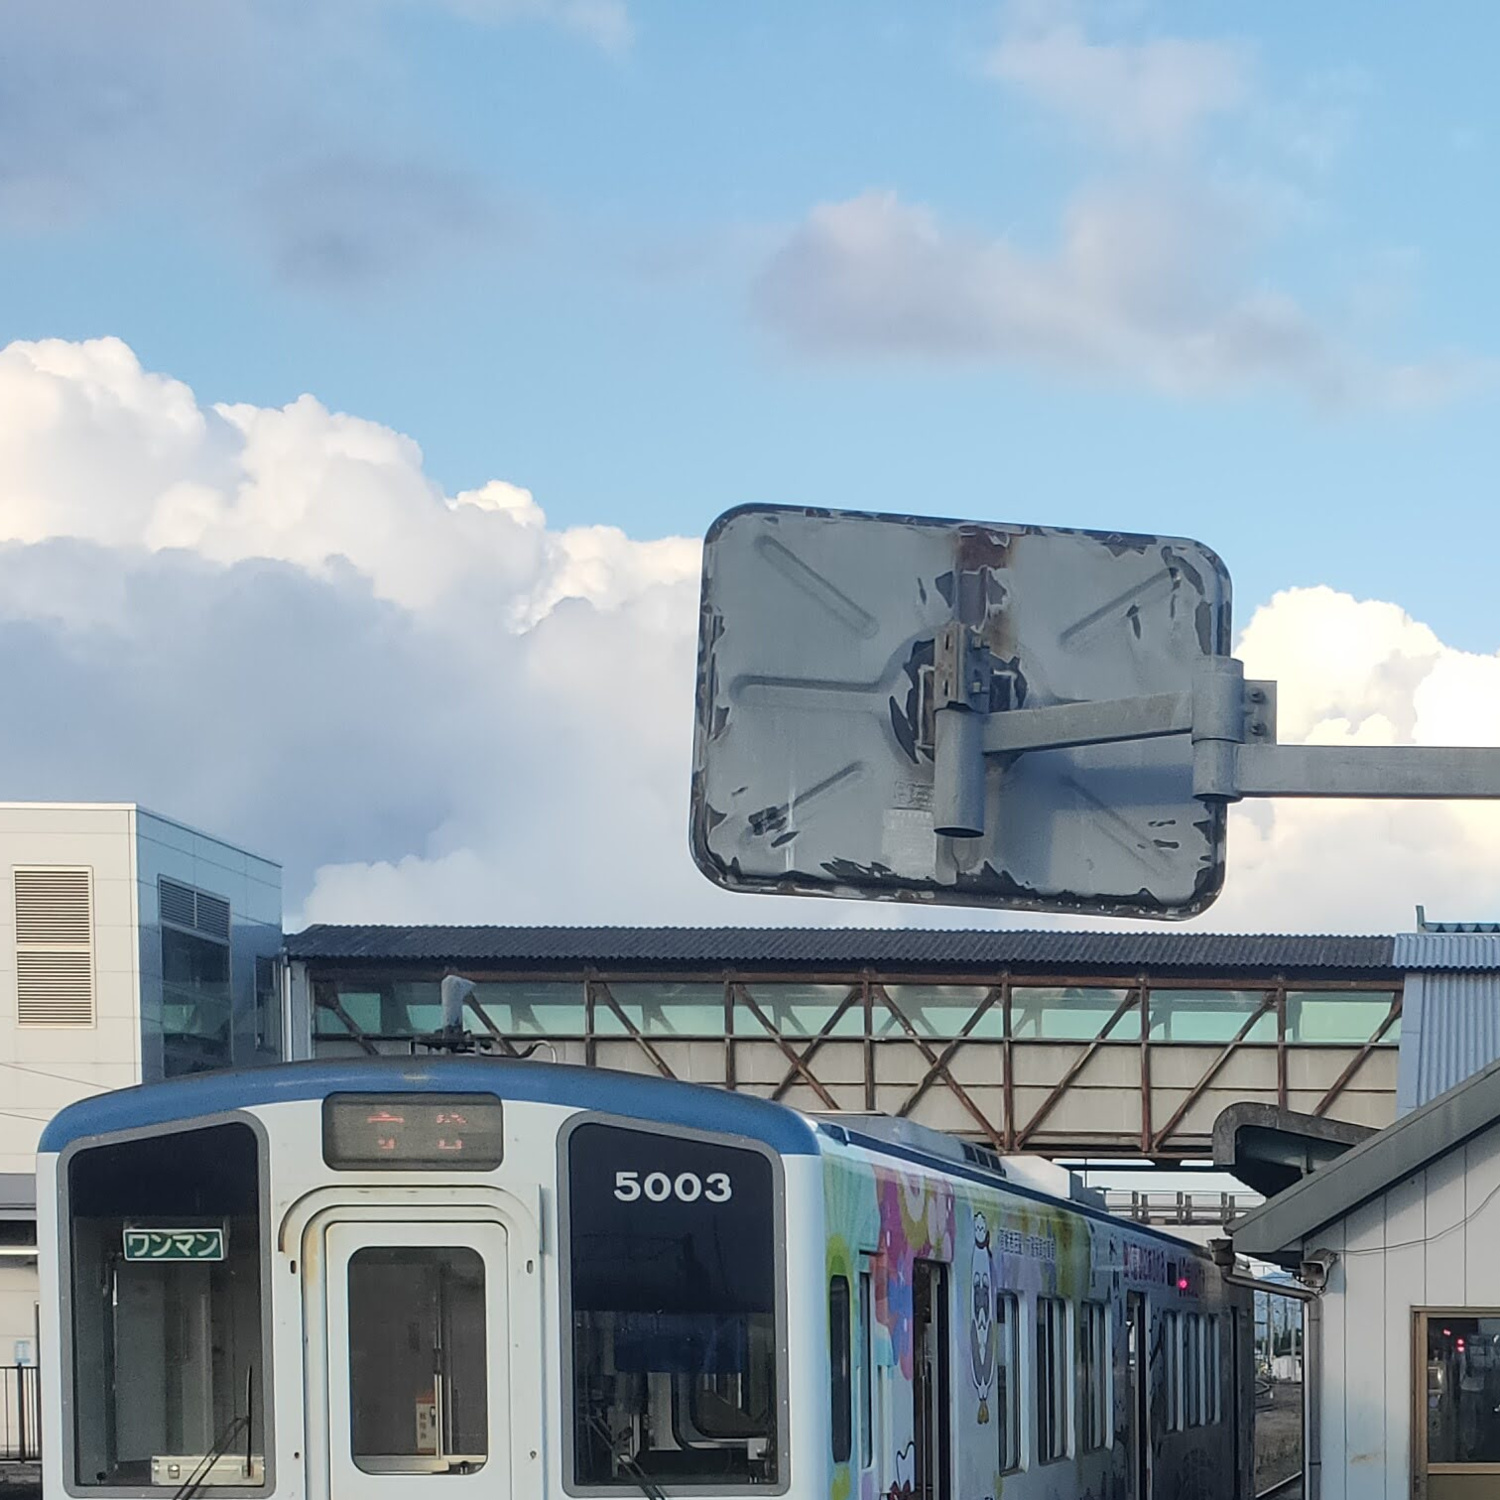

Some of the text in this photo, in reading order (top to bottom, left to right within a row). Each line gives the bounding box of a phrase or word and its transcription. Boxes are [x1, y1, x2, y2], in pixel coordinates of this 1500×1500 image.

[614, 1171, 732, 1202] 5003
[128, 1233, 219, 1257] ワンマン
